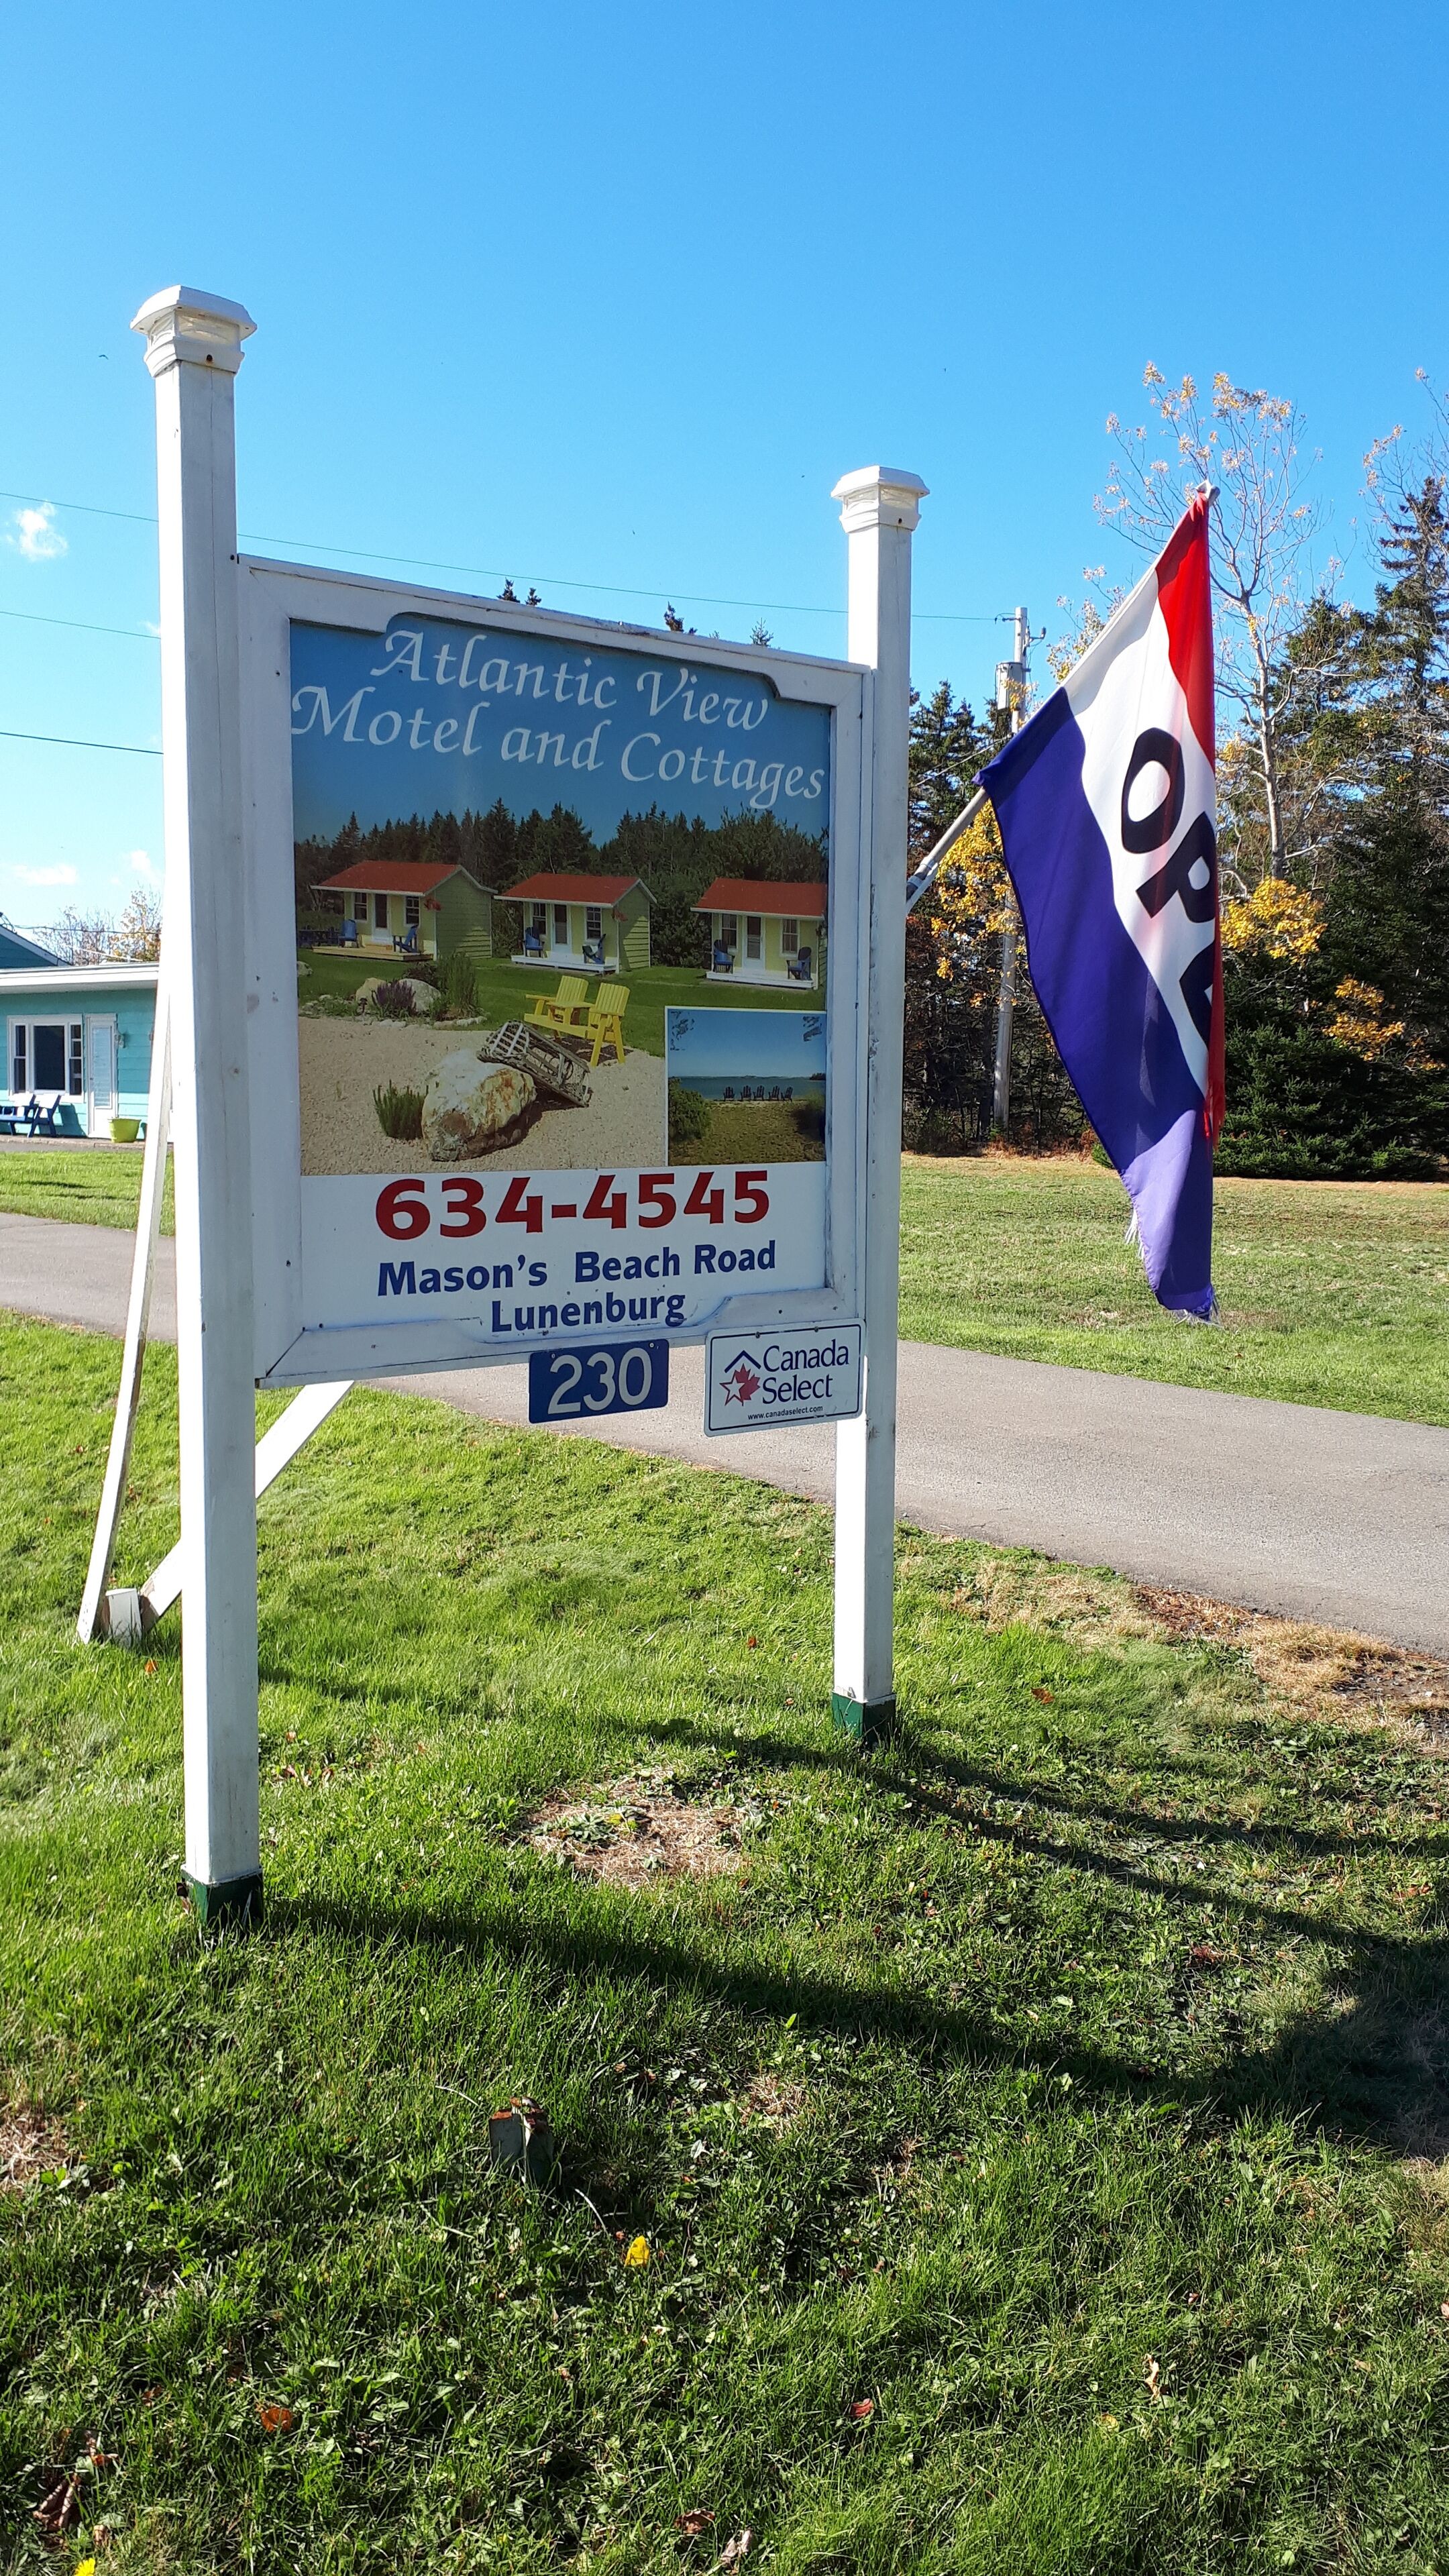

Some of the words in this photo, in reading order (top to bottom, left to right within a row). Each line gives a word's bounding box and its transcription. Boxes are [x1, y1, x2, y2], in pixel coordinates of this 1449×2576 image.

[370, 629, 619, 709] Atlantic
[637, 668, 769, 731] View
[291, 686, 490, 757] Motel
[501, 720, 612, 772] and
[621, 732, 825, 810] Cottages
[375, 1170, 769, 1240] 634-4545
[378, 1254, 547, 1296] Mason's
[574, 1246, 680, 1283] Beach
[694, 1240, 776, 1275] Road
[491, 1292, 686, 1333] Lunenburg
[547, 1347, 653, 1415] 230
[763, 1338, 849, 1373] Canada
[747, 1405, 823, 1420] www.canadaselect.com
[762, 1374, 833, 1405] Select
